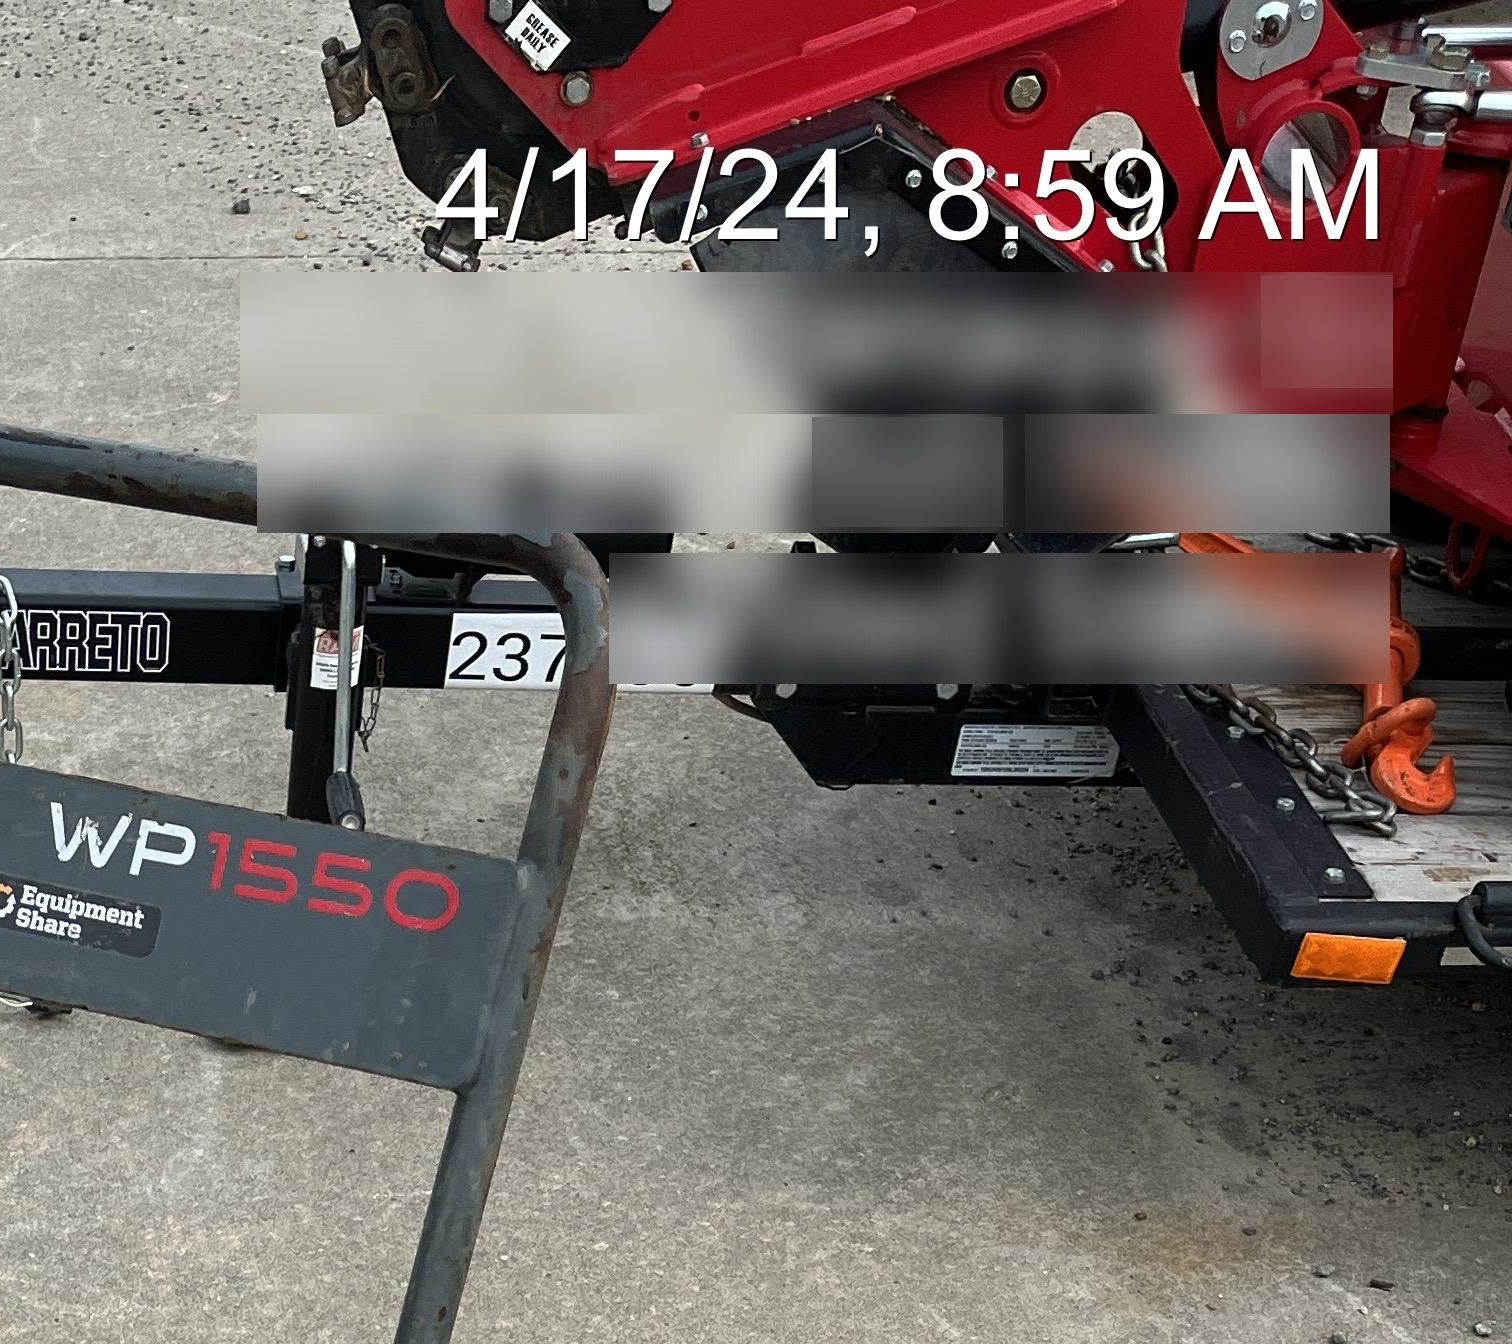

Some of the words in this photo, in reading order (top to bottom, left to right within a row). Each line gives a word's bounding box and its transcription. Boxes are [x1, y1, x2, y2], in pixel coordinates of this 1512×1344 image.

[520, 26, 547, 53] DAILY
[525, 13, 560, 48] GREASE
[50, 801, 462, 934] WP1550
[15, 907, 82, 939] Share
[20, 884, 145, 930] Equipment
